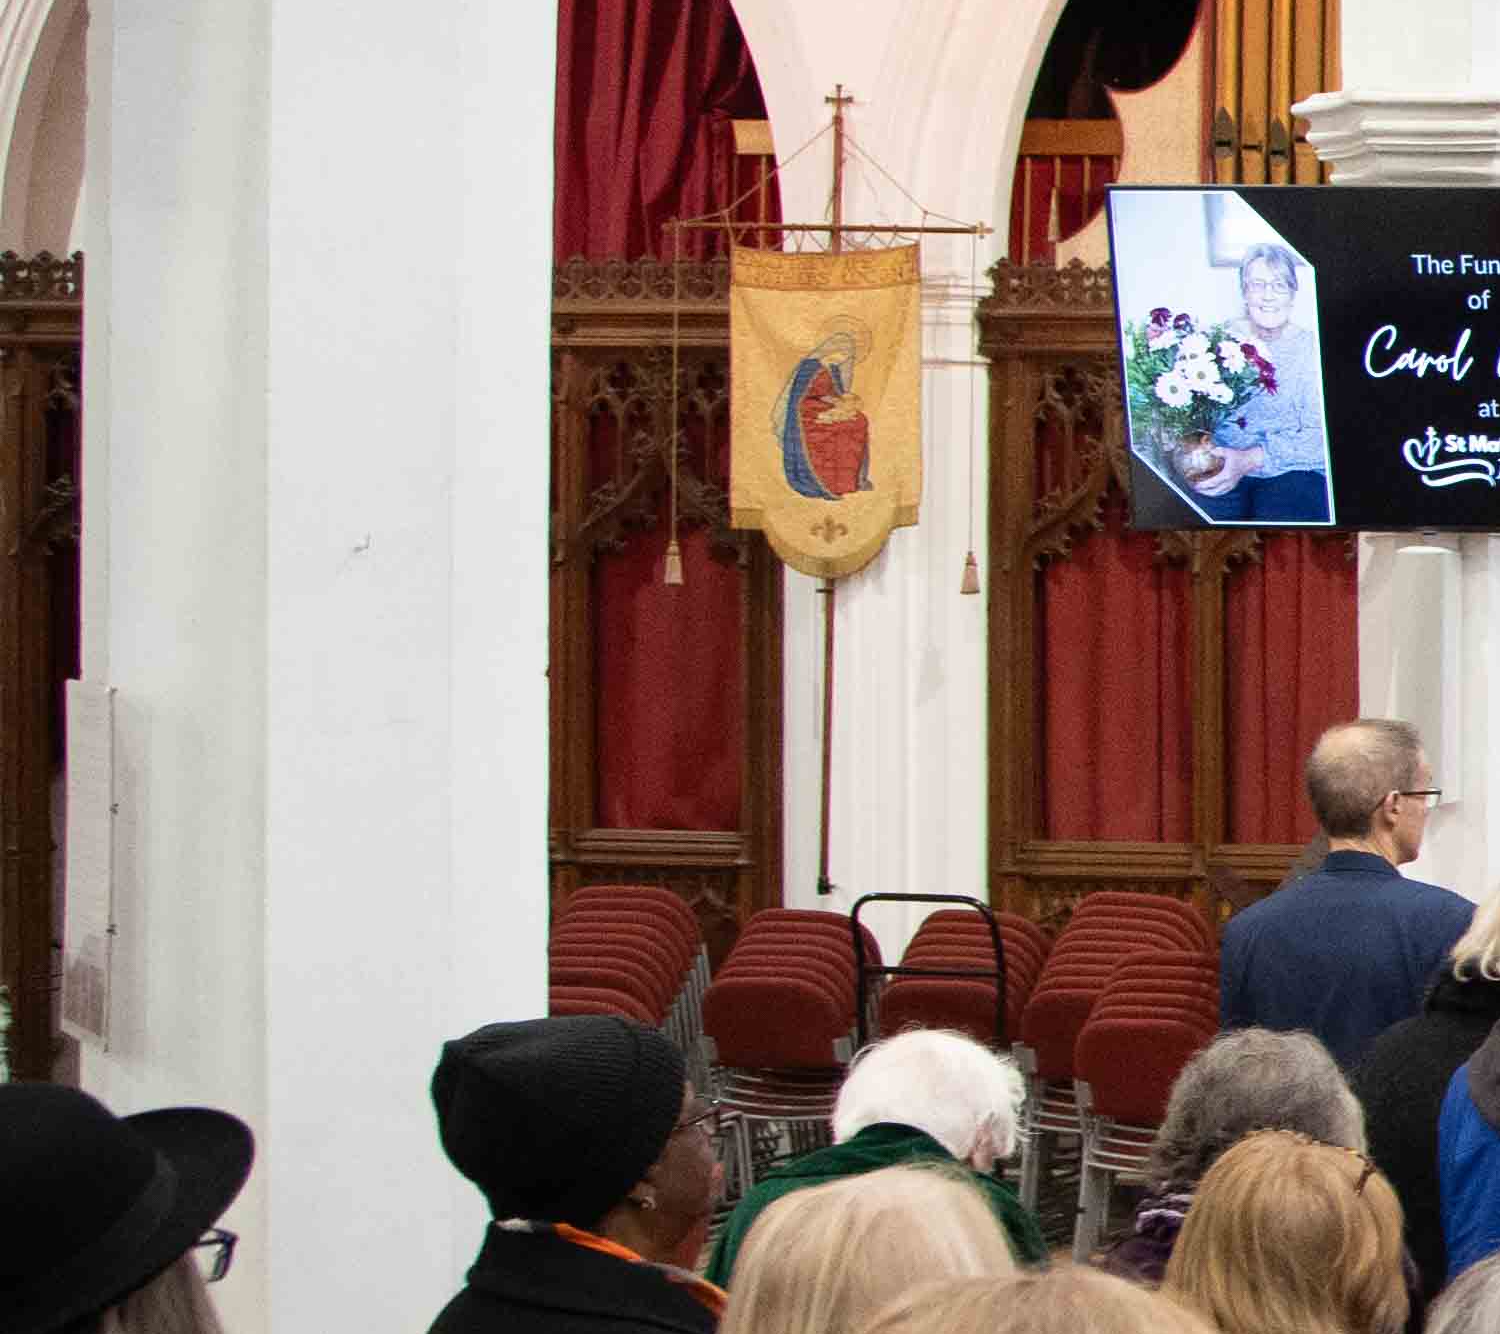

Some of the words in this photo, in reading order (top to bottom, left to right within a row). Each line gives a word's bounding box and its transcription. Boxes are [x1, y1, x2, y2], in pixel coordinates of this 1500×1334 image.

[1410, 254, 1454, 275] The
[1467, 289, 1491, 309] of
[1365, 324, 1474, 381] Carol
[1478, 399, 1500, 418] at
[1445, 434, 1467, 453] St
